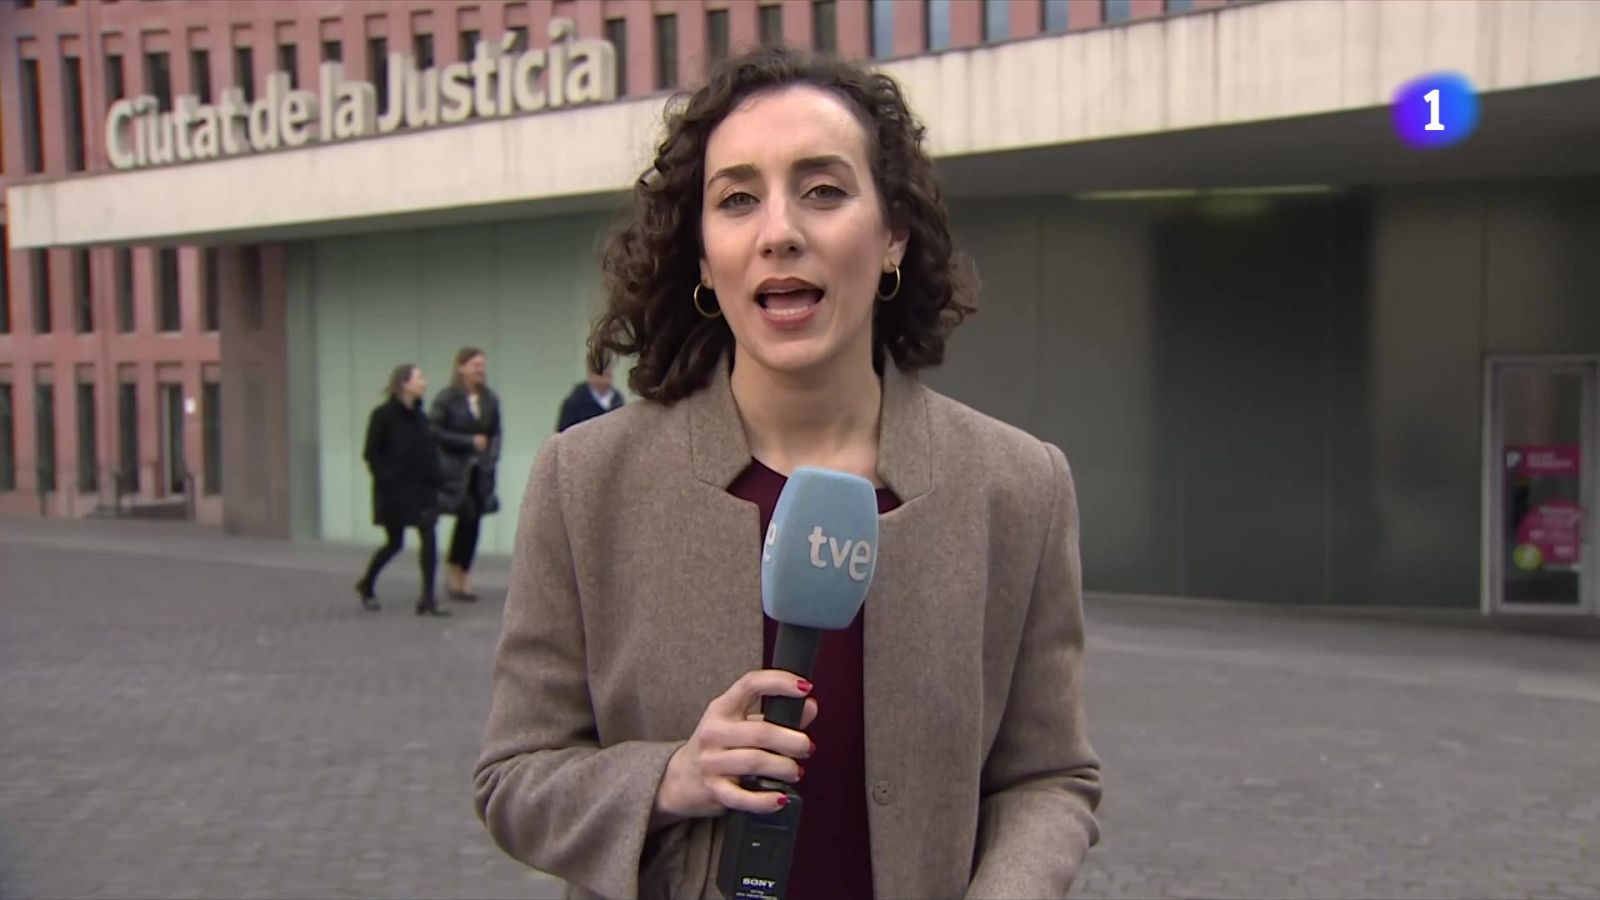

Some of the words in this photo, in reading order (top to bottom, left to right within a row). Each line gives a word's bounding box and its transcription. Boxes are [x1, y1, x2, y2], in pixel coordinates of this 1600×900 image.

[106, 88, 247, 169] Ciutat
[250, 71, 314, 150] de
[319, 61, 375, 142] la
[377, 18, 616, 133] Justícia
[808, 526, 871, 580] tve
[742, 877, 776, 888] SONY
